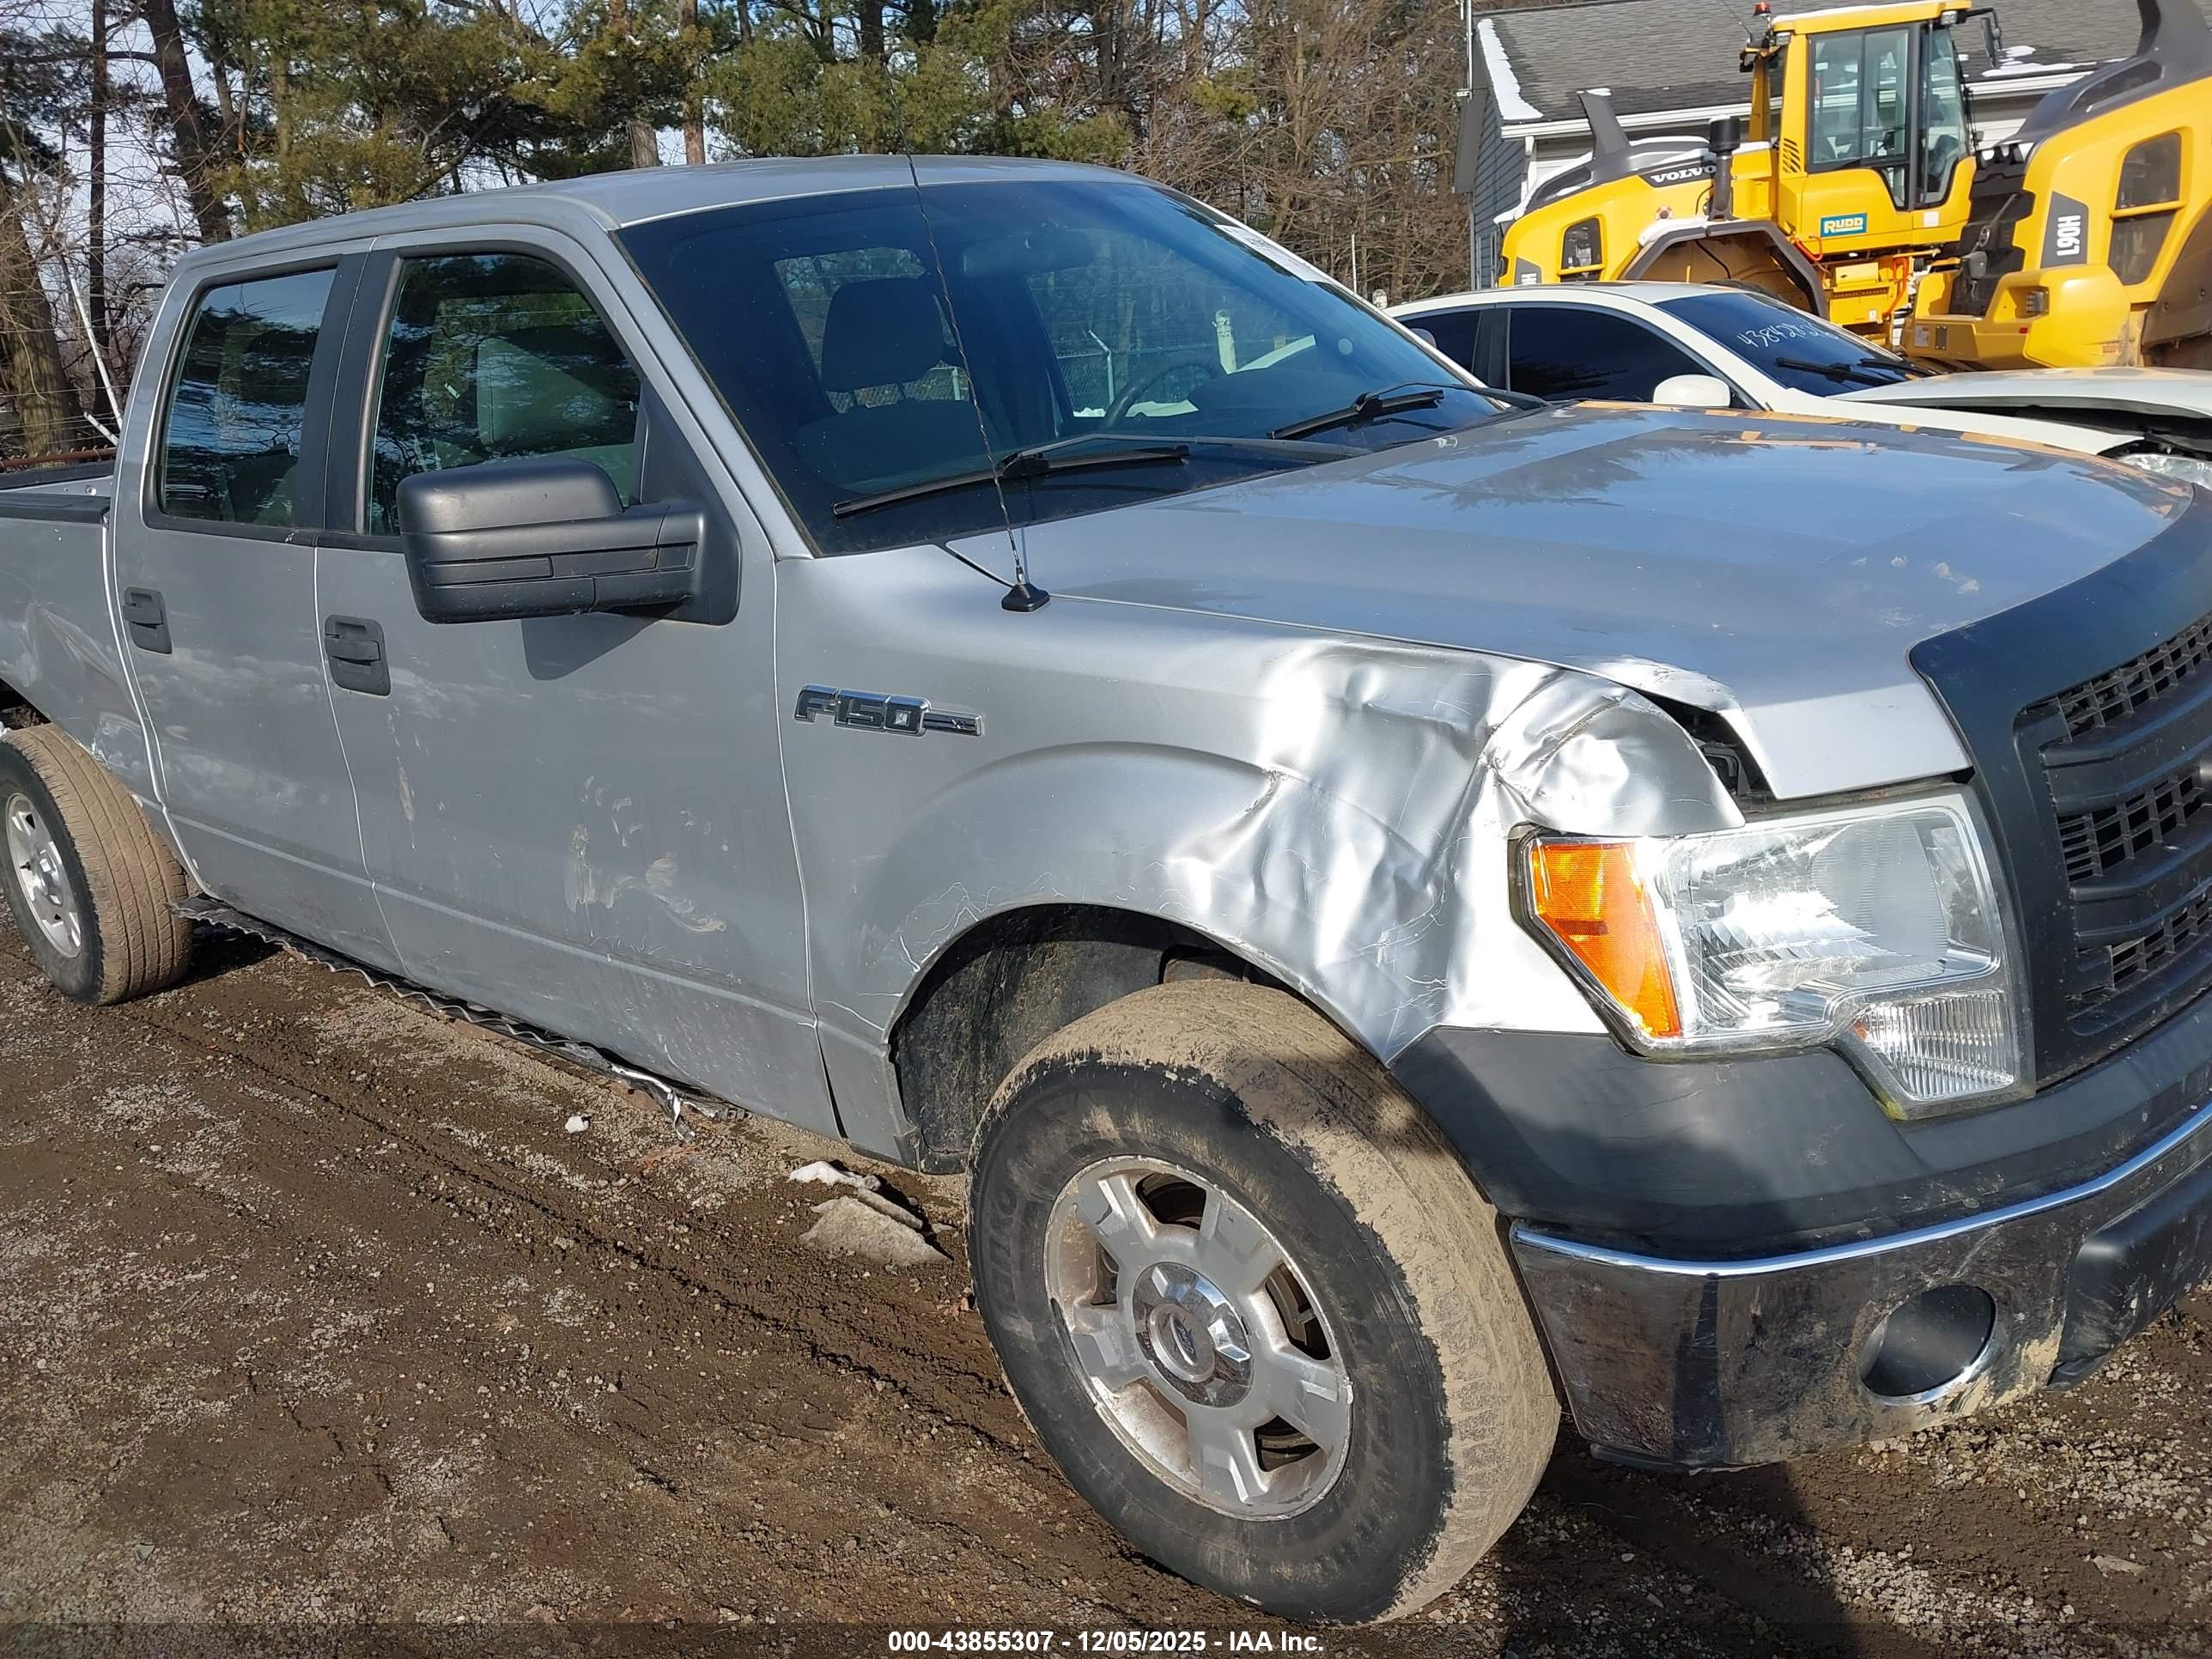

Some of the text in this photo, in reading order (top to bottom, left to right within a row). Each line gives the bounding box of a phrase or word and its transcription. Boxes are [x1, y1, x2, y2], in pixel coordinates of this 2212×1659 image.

[1650, 164, 1717, 184] VOLVO
[1823, 216, 1864, 234] RUDD
[2057, 215, 2081, 257] L90H
